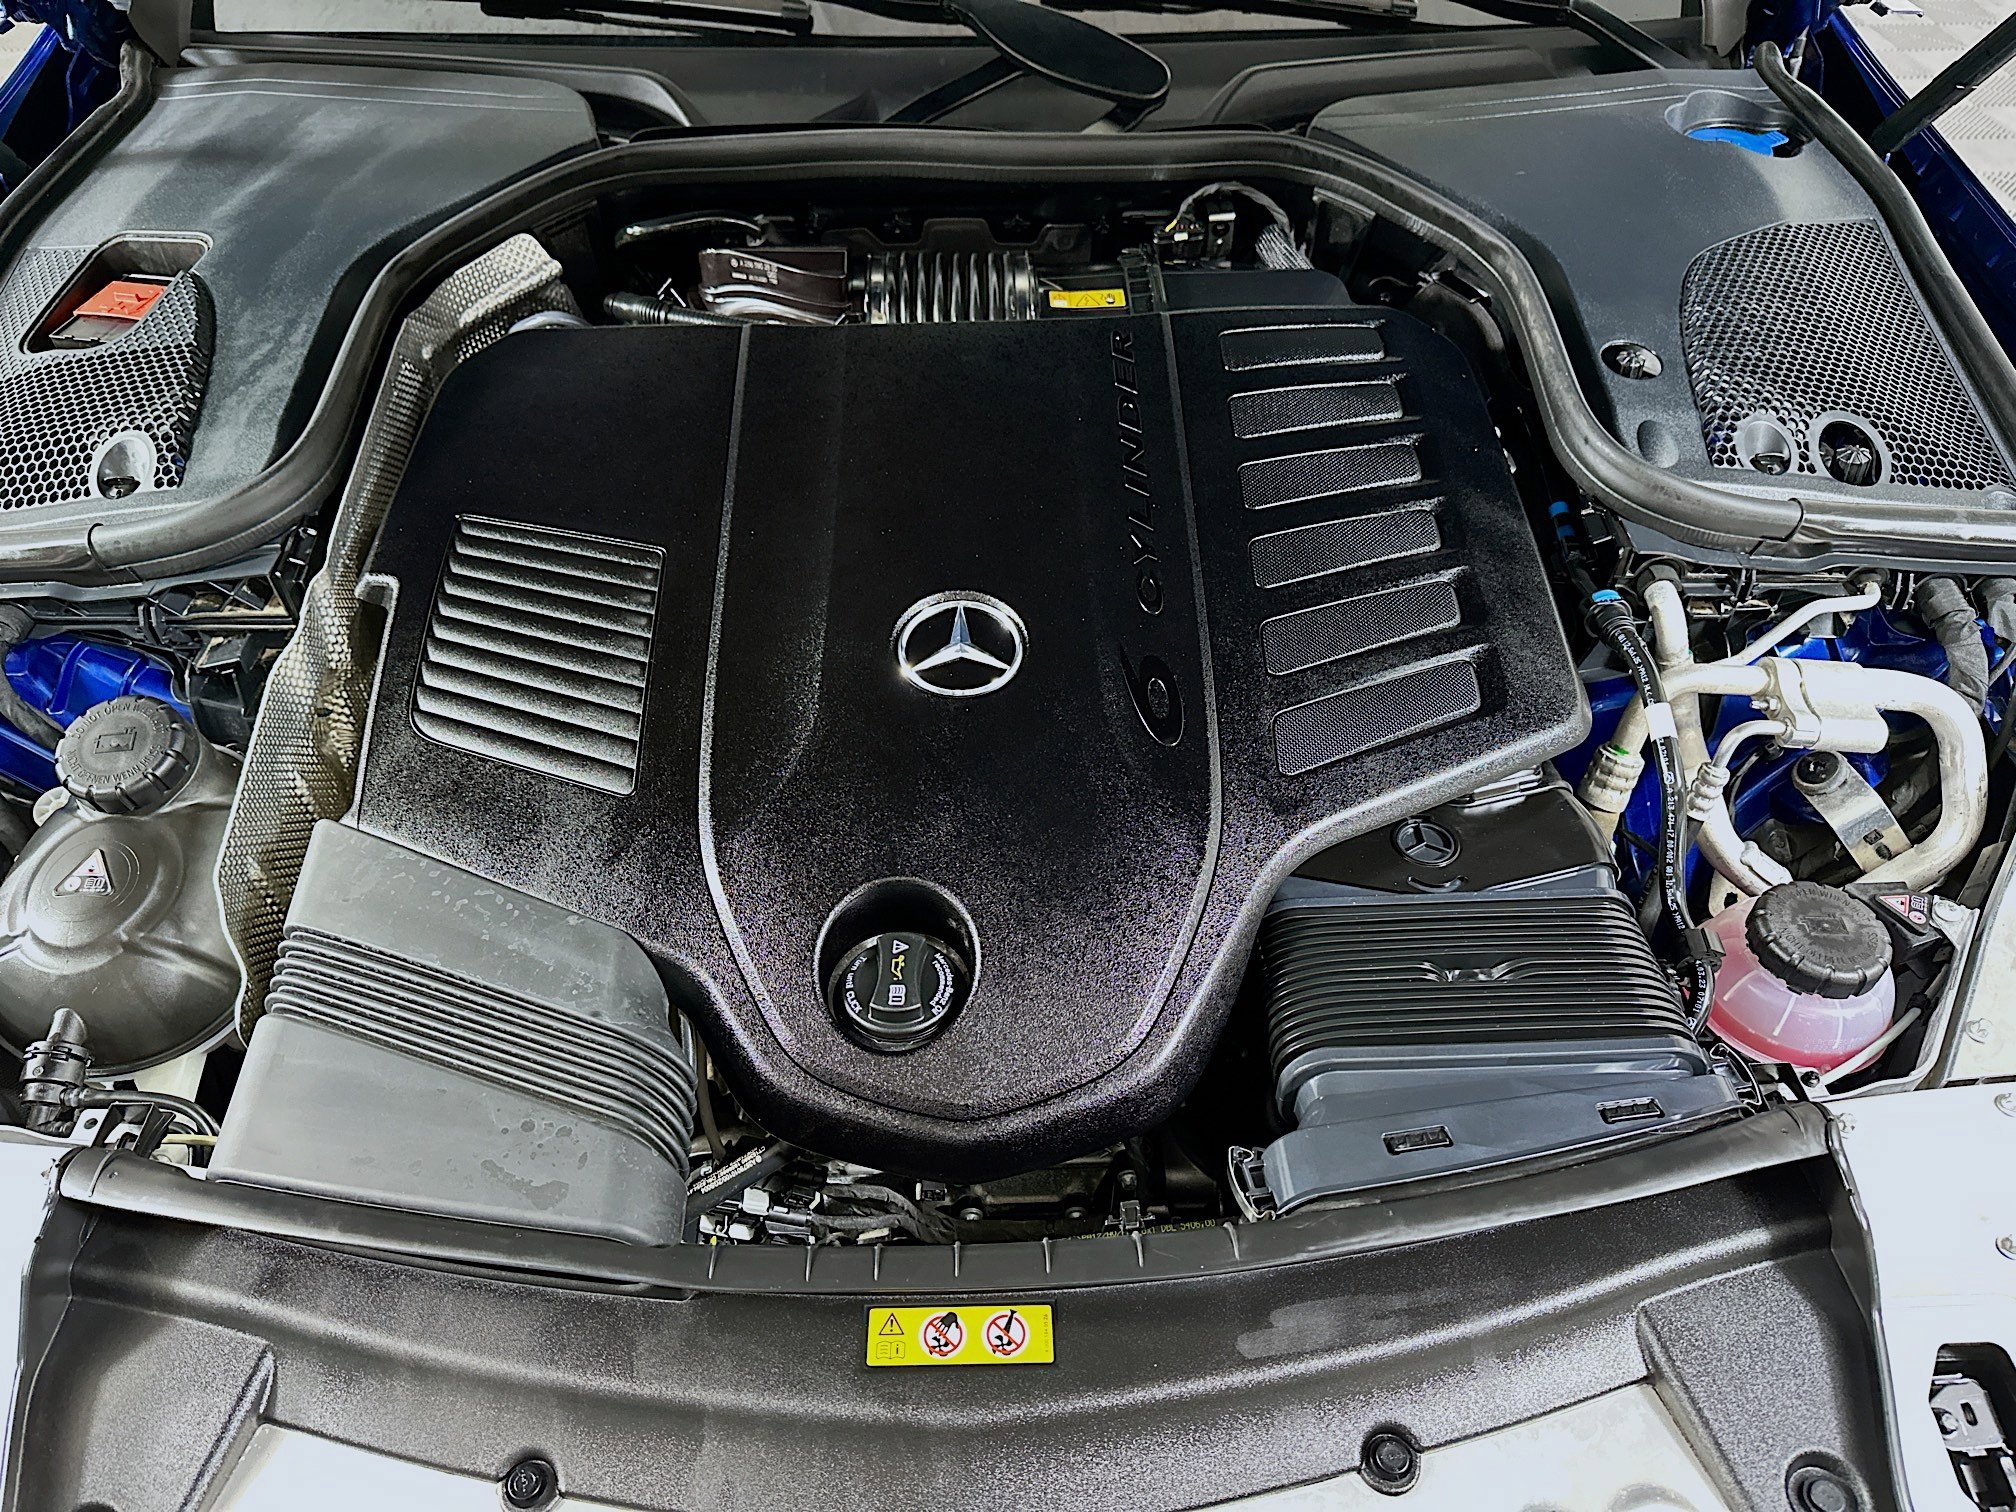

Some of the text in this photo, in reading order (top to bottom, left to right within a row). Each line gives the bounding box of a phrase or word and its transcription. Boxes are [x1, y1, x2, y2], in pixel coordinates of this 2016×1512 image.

[1110, 327, 1185, 747] 6 CYLINDER
[83, 710, 102, 728] NOT
[104, 703, 132, 717] OPEN
[112, 763, 142, 783] WENN
[850, 956, 868, 971] Turn
[934, 952, 954, 1006] Mercedes-Benz
[846, 990, 863, 1014] CLICK
[1160, 1224, 1178, 1234] DBL
